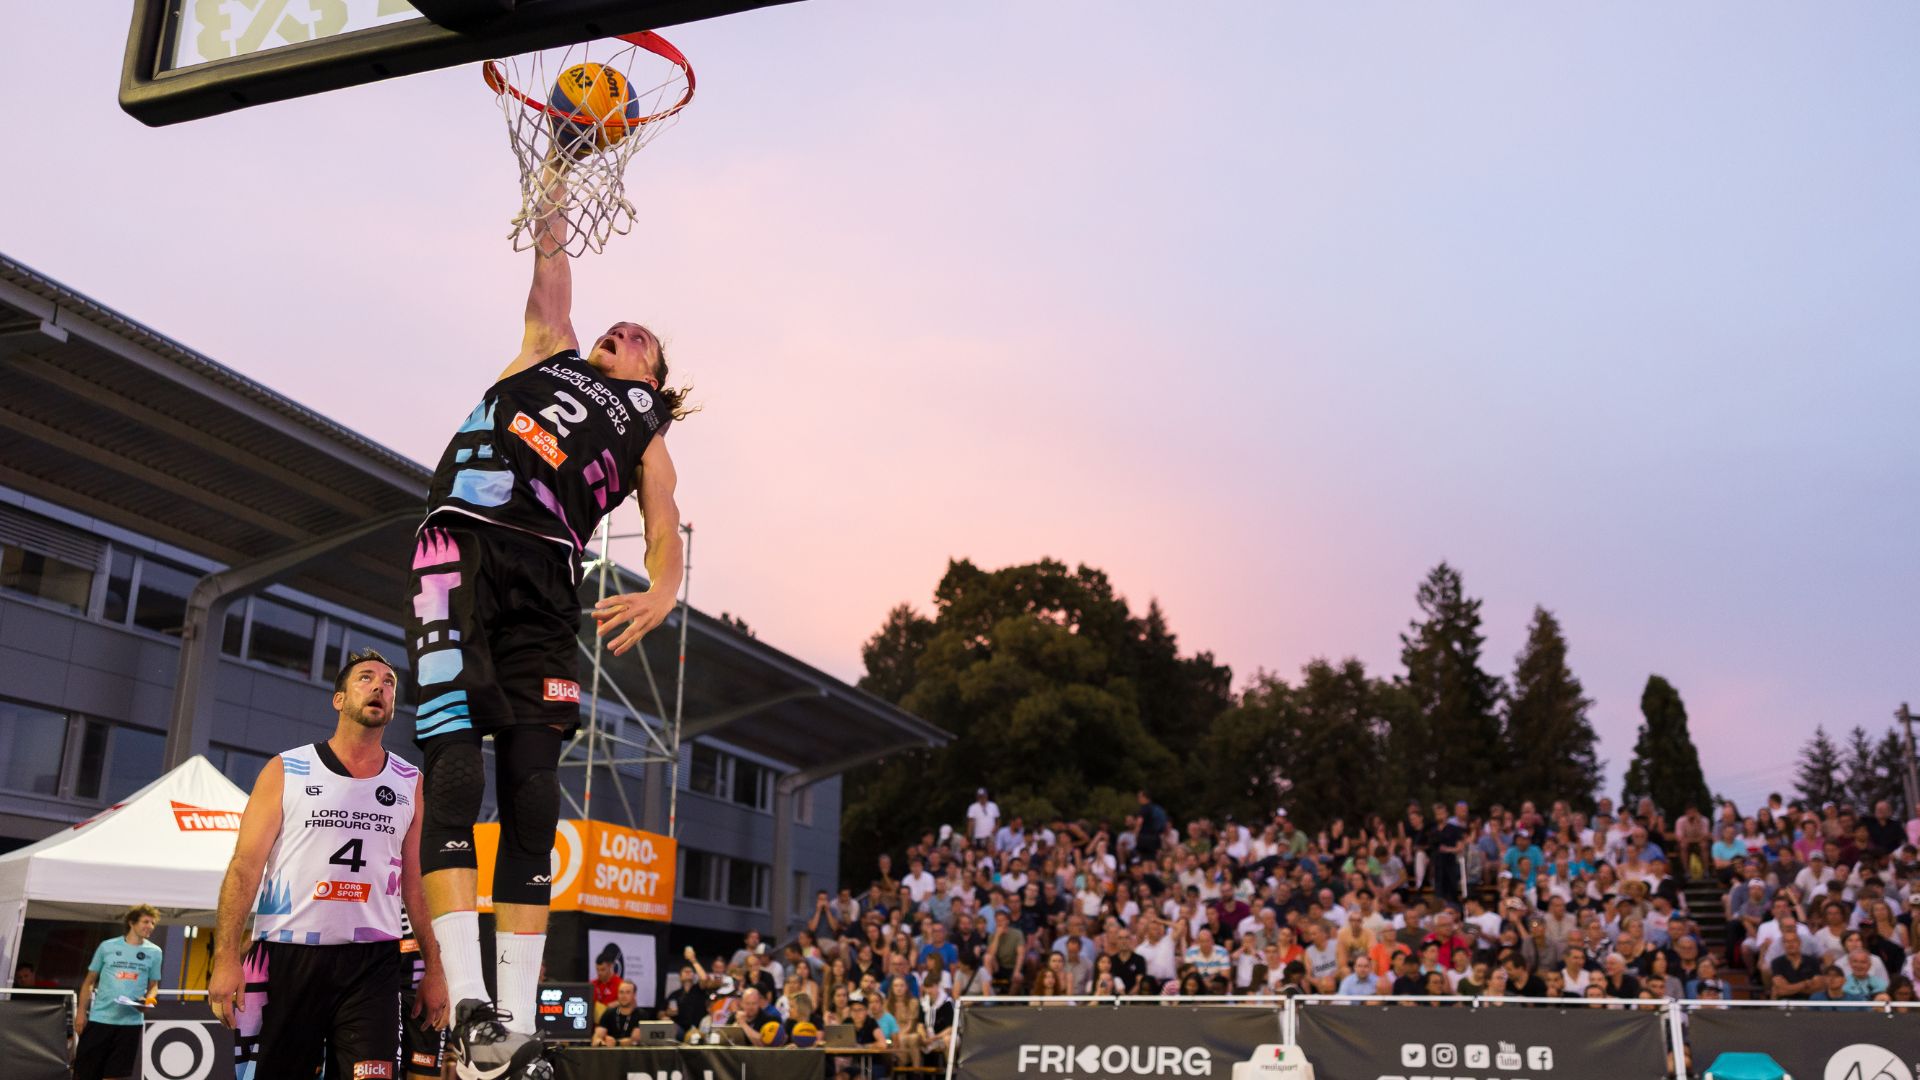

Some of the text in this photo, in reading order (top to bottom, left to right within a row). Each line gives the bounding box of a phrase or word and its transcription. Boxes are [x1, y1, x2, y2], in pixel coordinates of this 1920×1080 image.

[538, 366, 607, 407] FRIBOURG
[606, 407, 626, 436] 3X3
[552, 363, 591, 382] LORO
[592, 382, 631, 422] SPORT
[538, 390, 588, 438] 2
[548, 682, 579, 700] Blick
[304, 819, 396, 835] FRIBOURG 3X3
[311, 809, 393, 824] LORO SPORT
[329, 838, 367, 873] 4
[601, 831, 658, 864] LORO-
[337, 890, 363, 898] SPORT
[594, 862, 661, 897] SPORT
[357, 1063, 386, 1077] Blick
